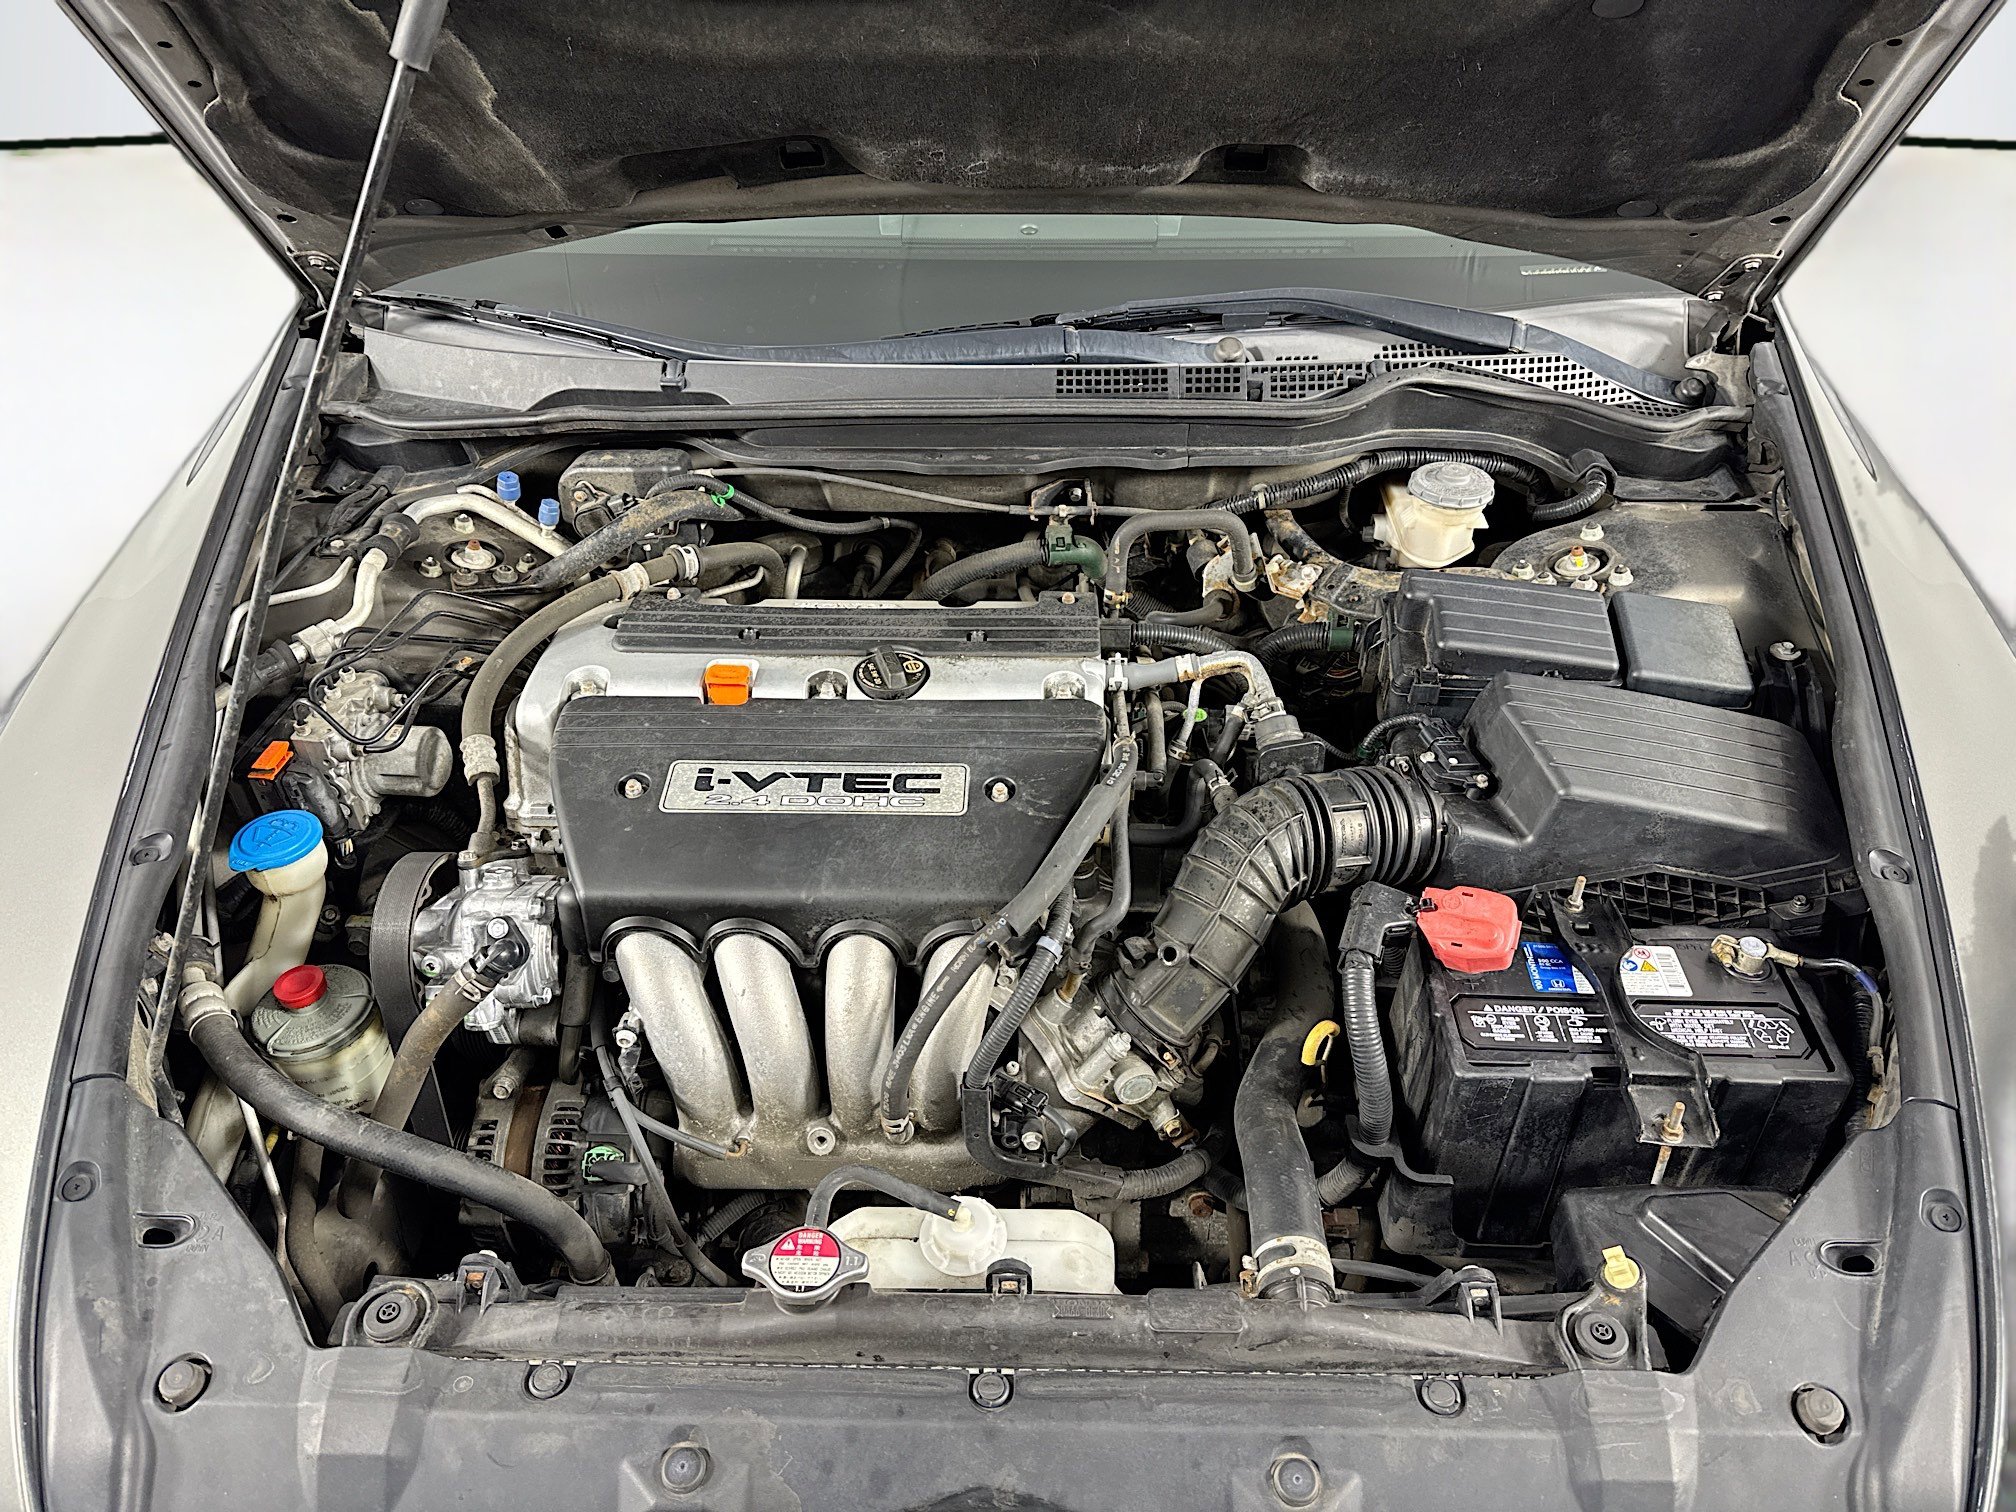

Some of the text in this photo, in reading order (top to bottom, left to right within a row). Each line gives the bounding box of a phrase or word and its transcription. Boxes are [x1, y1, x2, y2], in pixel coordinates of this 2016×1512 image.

[694, 767, 942, 794] i-VTEC
[703, 794, 925, 807] 2.4 DOHC
[914, 993, 940, 1024] ENGINE
[1494, 1004, 1535, 1013] DANGER
[1545, 1006, 1584, 1014] POISON
[845, 1256, 859, 1266] 1.1
